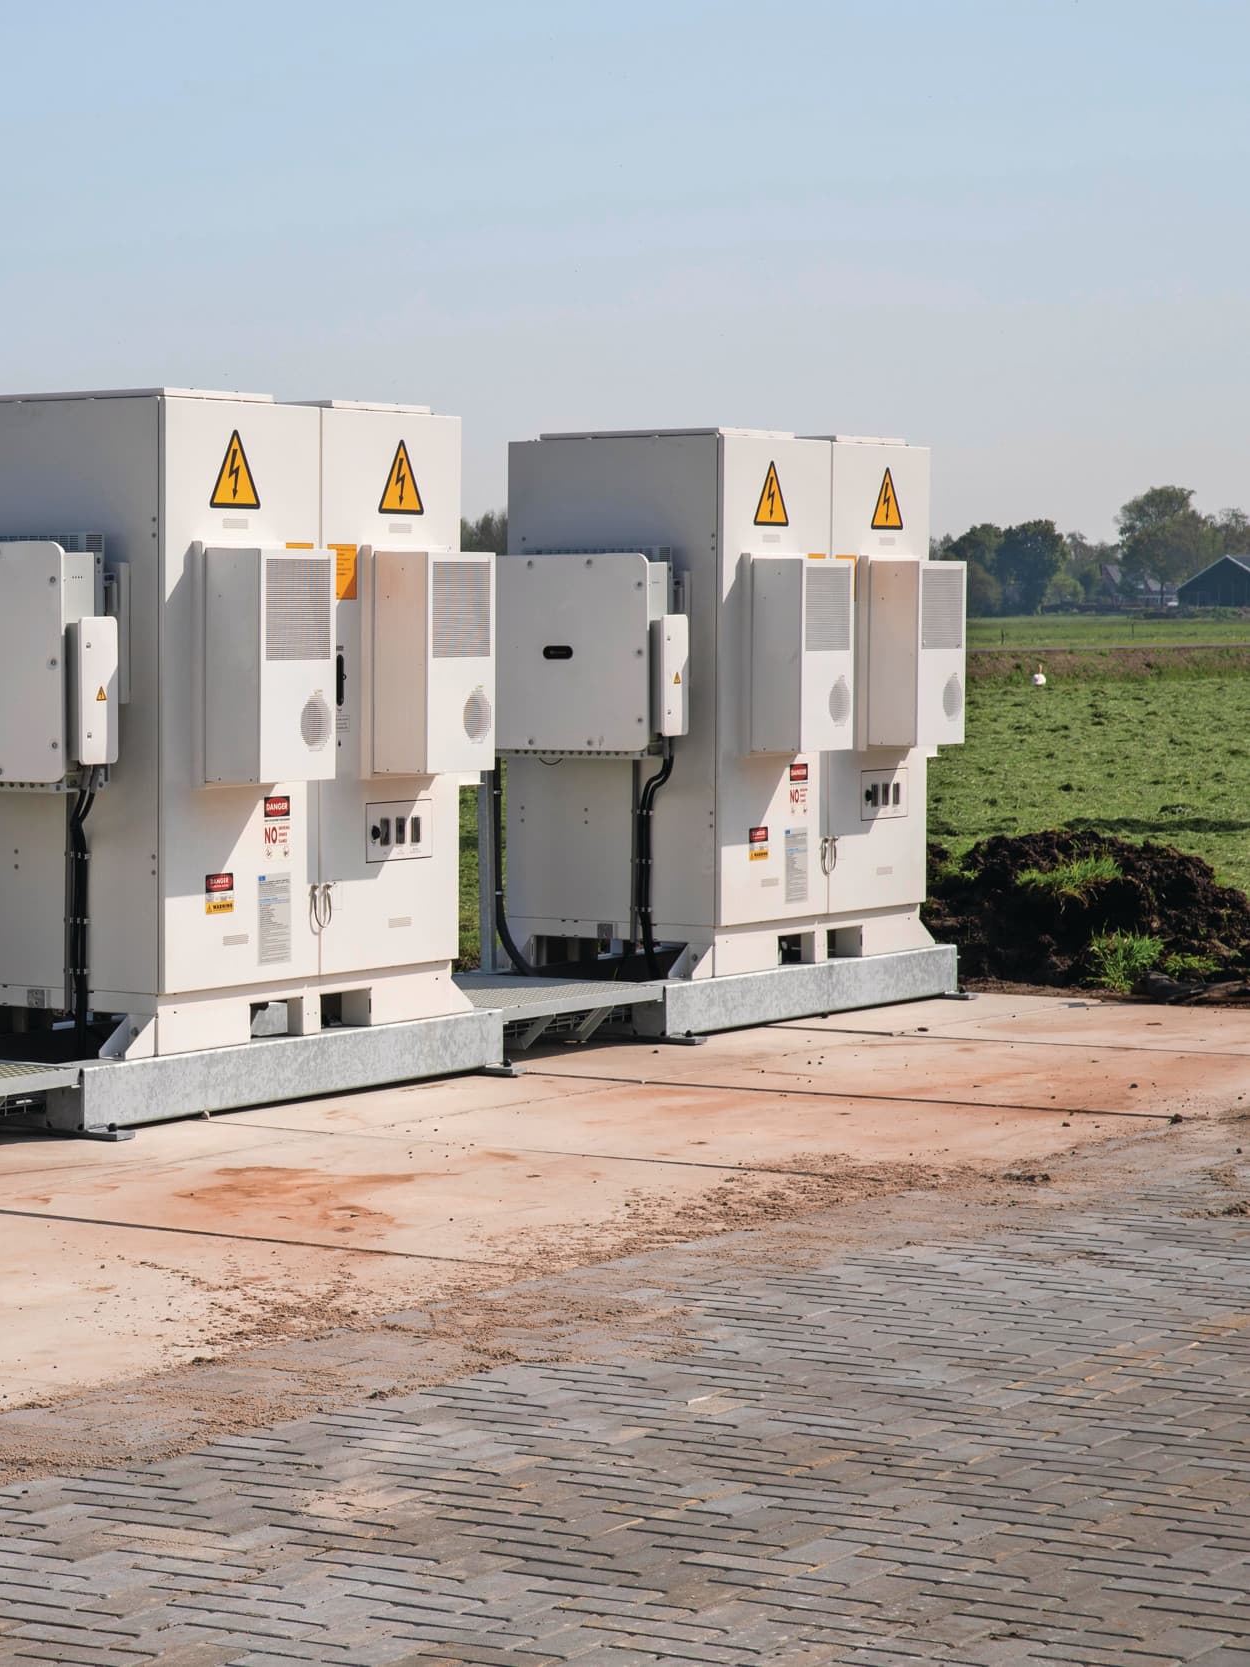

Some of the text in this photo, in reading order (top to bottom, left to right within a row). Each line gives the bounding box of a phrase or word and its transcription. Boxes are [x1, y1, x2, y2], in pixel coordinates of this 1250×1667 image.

[790, 789, 799, 804] NO
[266, 802, 288, 811] DANGER
[264, 826, 278, 844] NO
